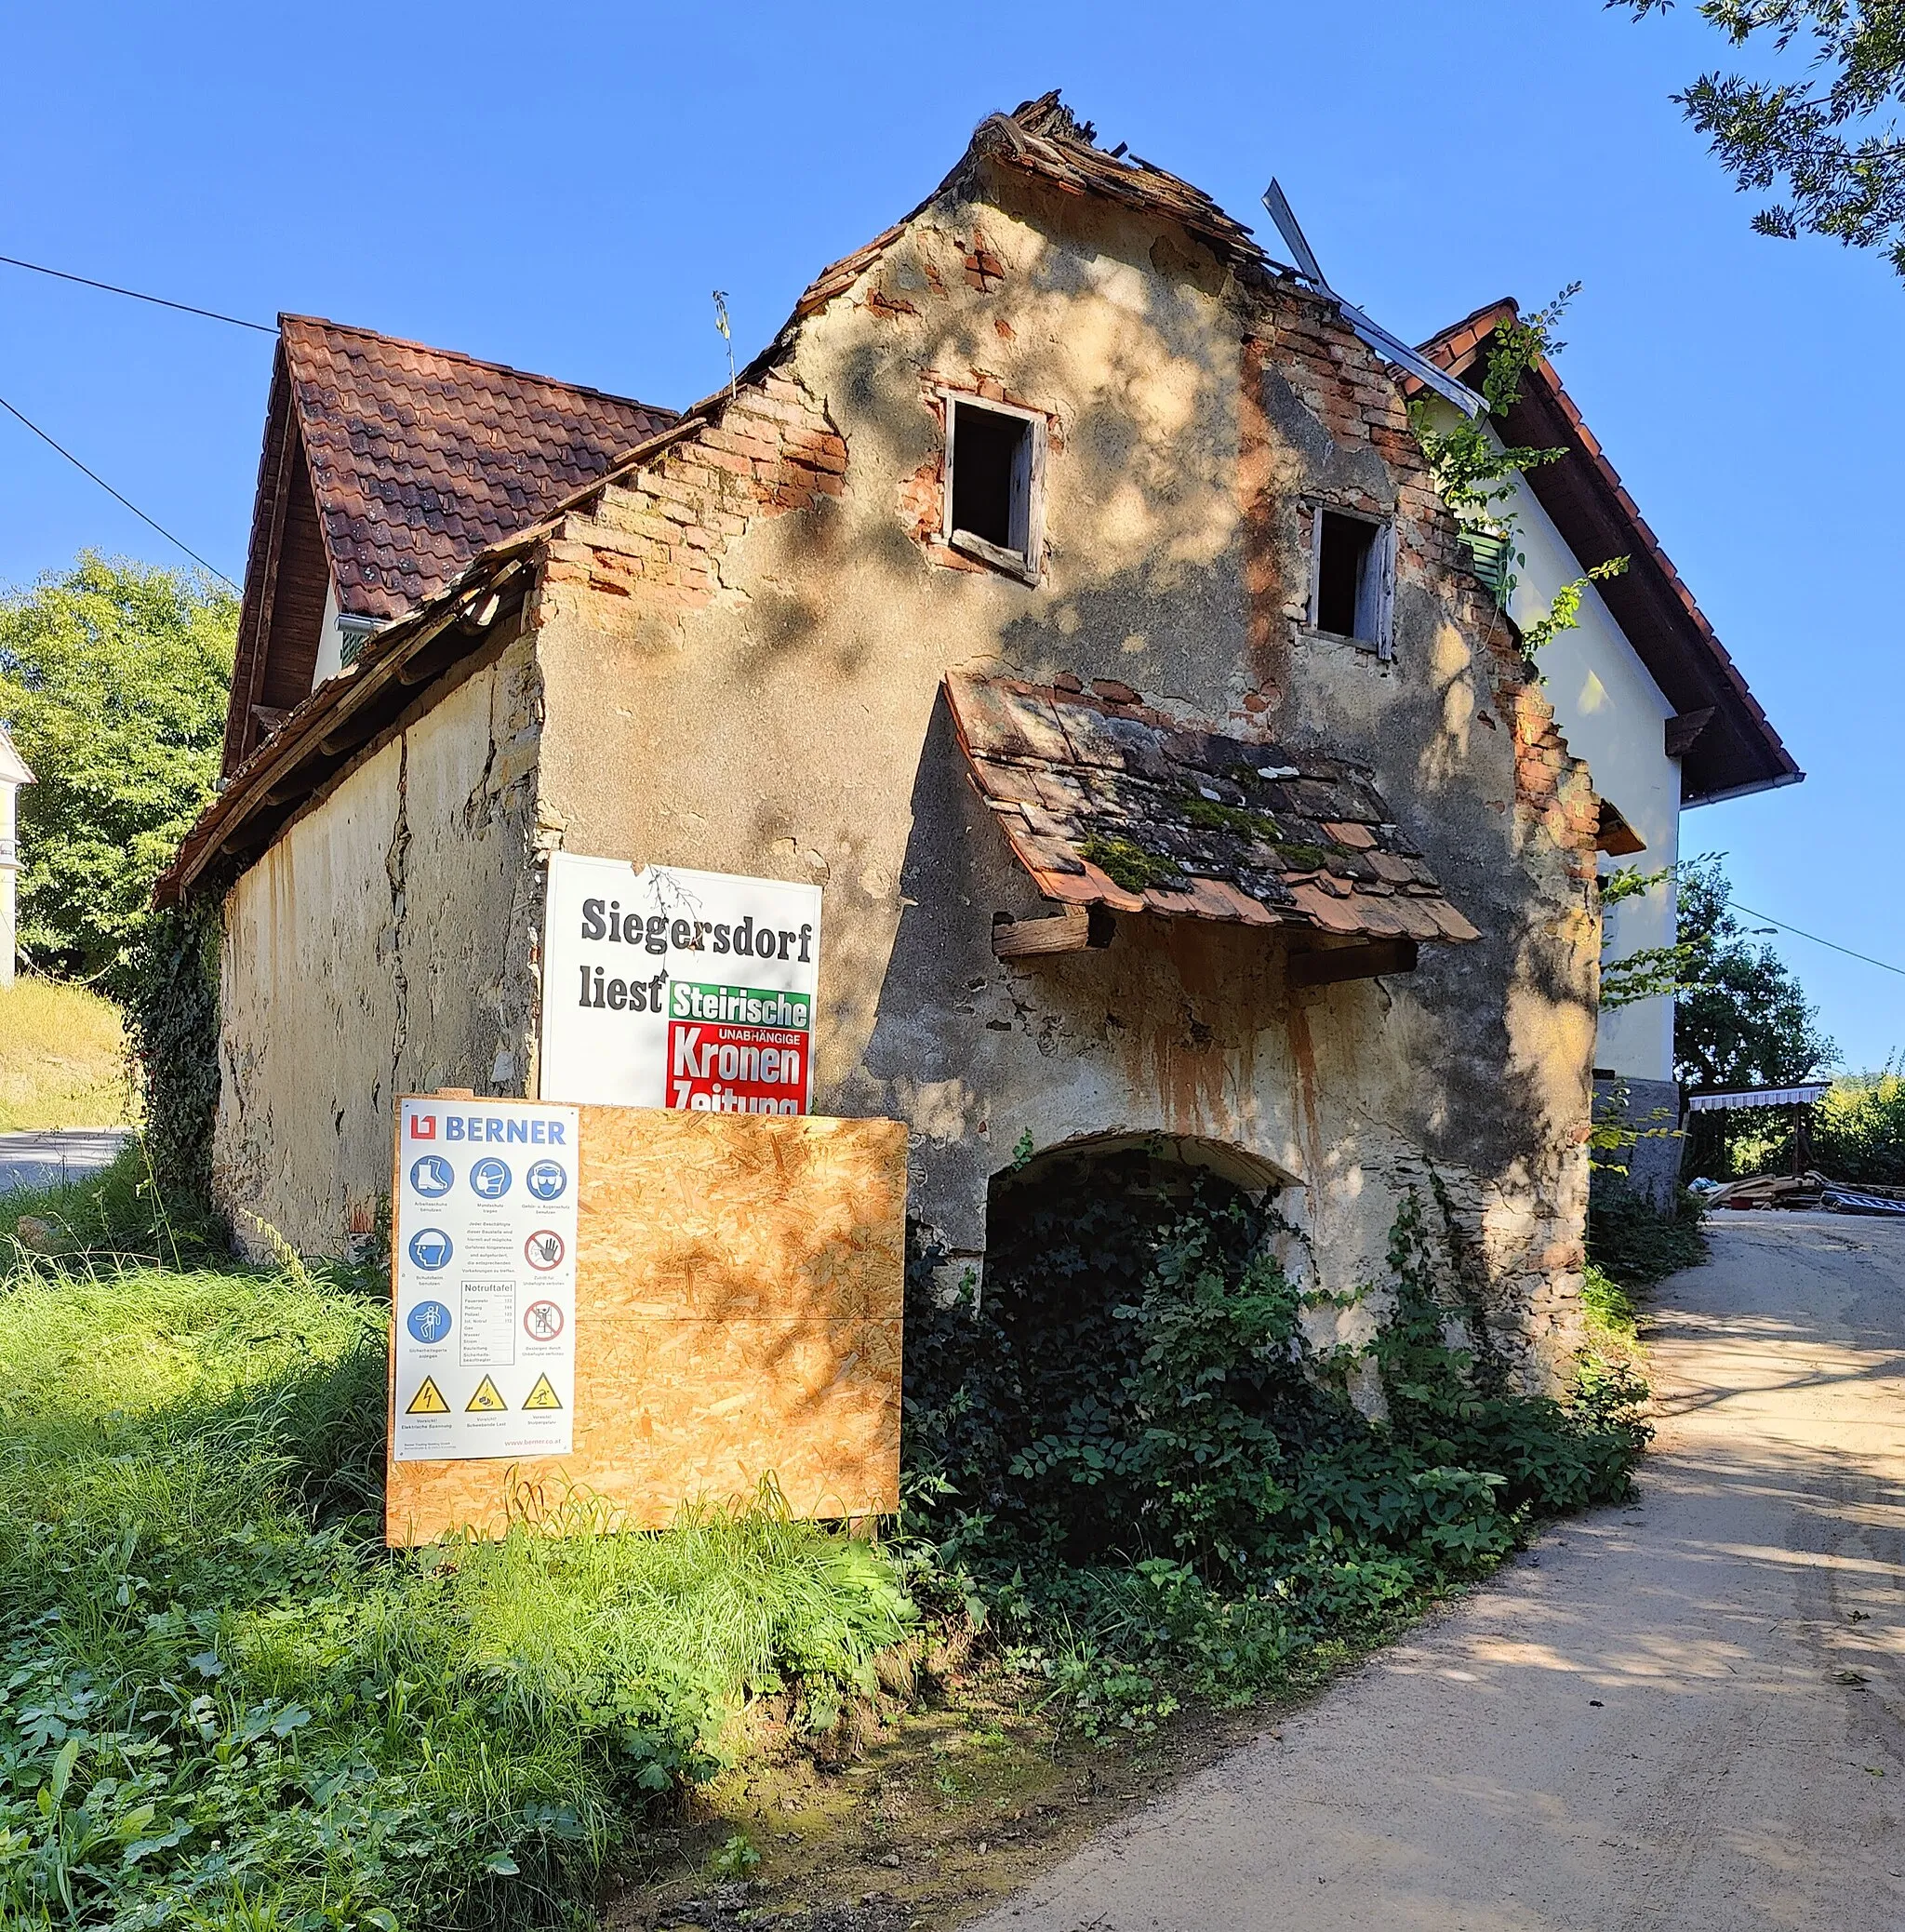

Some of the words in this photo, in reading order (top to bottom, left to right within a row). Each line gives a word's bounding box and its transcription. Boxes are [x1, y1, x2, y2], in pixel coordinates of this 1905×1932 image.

[581, 899, 812, 963] Siegersdorf
[579, 966, 663, 1013] liest
[672, 982, 807, 1028] Steirische
[673, 1025, 800, 1085] Kronen
[719, 1028, 801, 1045] UNABHÄNGIGE
[446, 1116, 566, 1145] BERNER
[464, 1284, 513, 1292] Notruftafel
